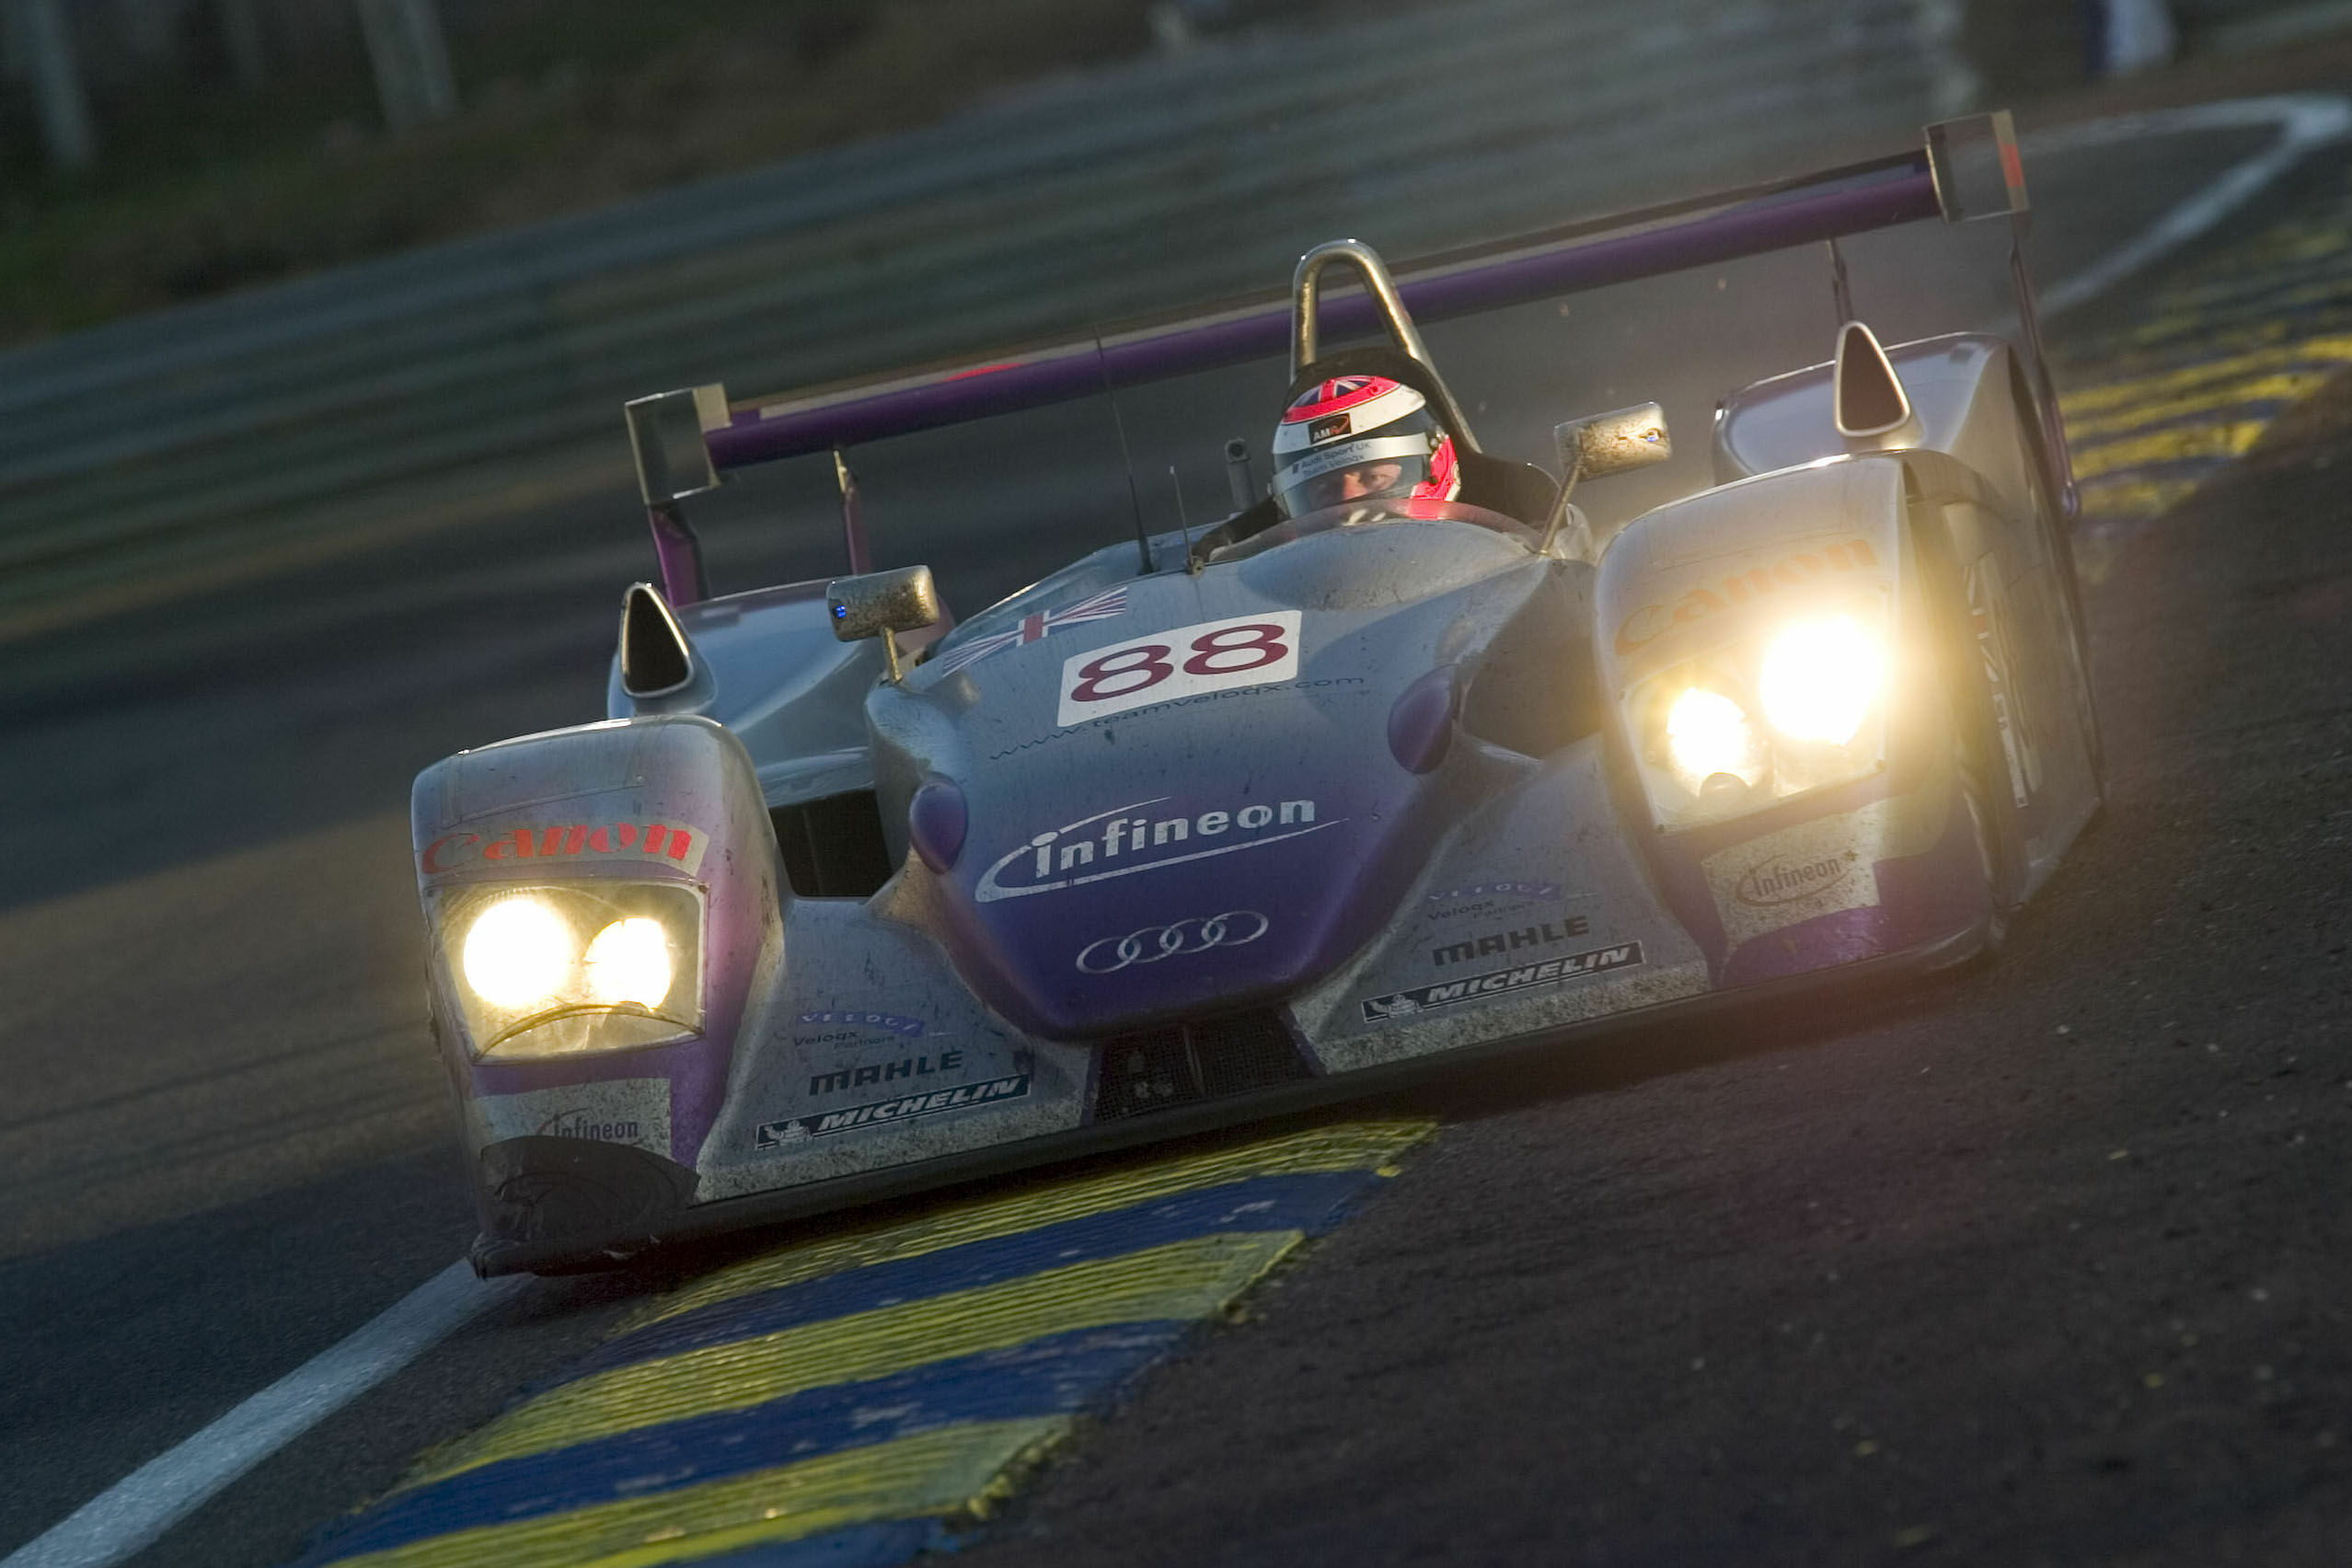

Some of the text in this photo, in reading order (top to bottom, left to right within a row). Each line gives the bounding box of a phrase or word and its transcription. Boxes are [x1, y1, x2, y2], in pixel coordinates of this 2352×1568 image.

[1615, 539, 1878, 656] Canon
[1071, 623, 1288, 702] 88
[422, 822, 692, 873] Canon
[1433, 916, 1589, 966] MAHLE
[1428, 946, 1631, 1002] MICHELIN
[809, 1050, 963, 1096] MAHLE
[818, 1078, 1020, 1131] MICHELIN
